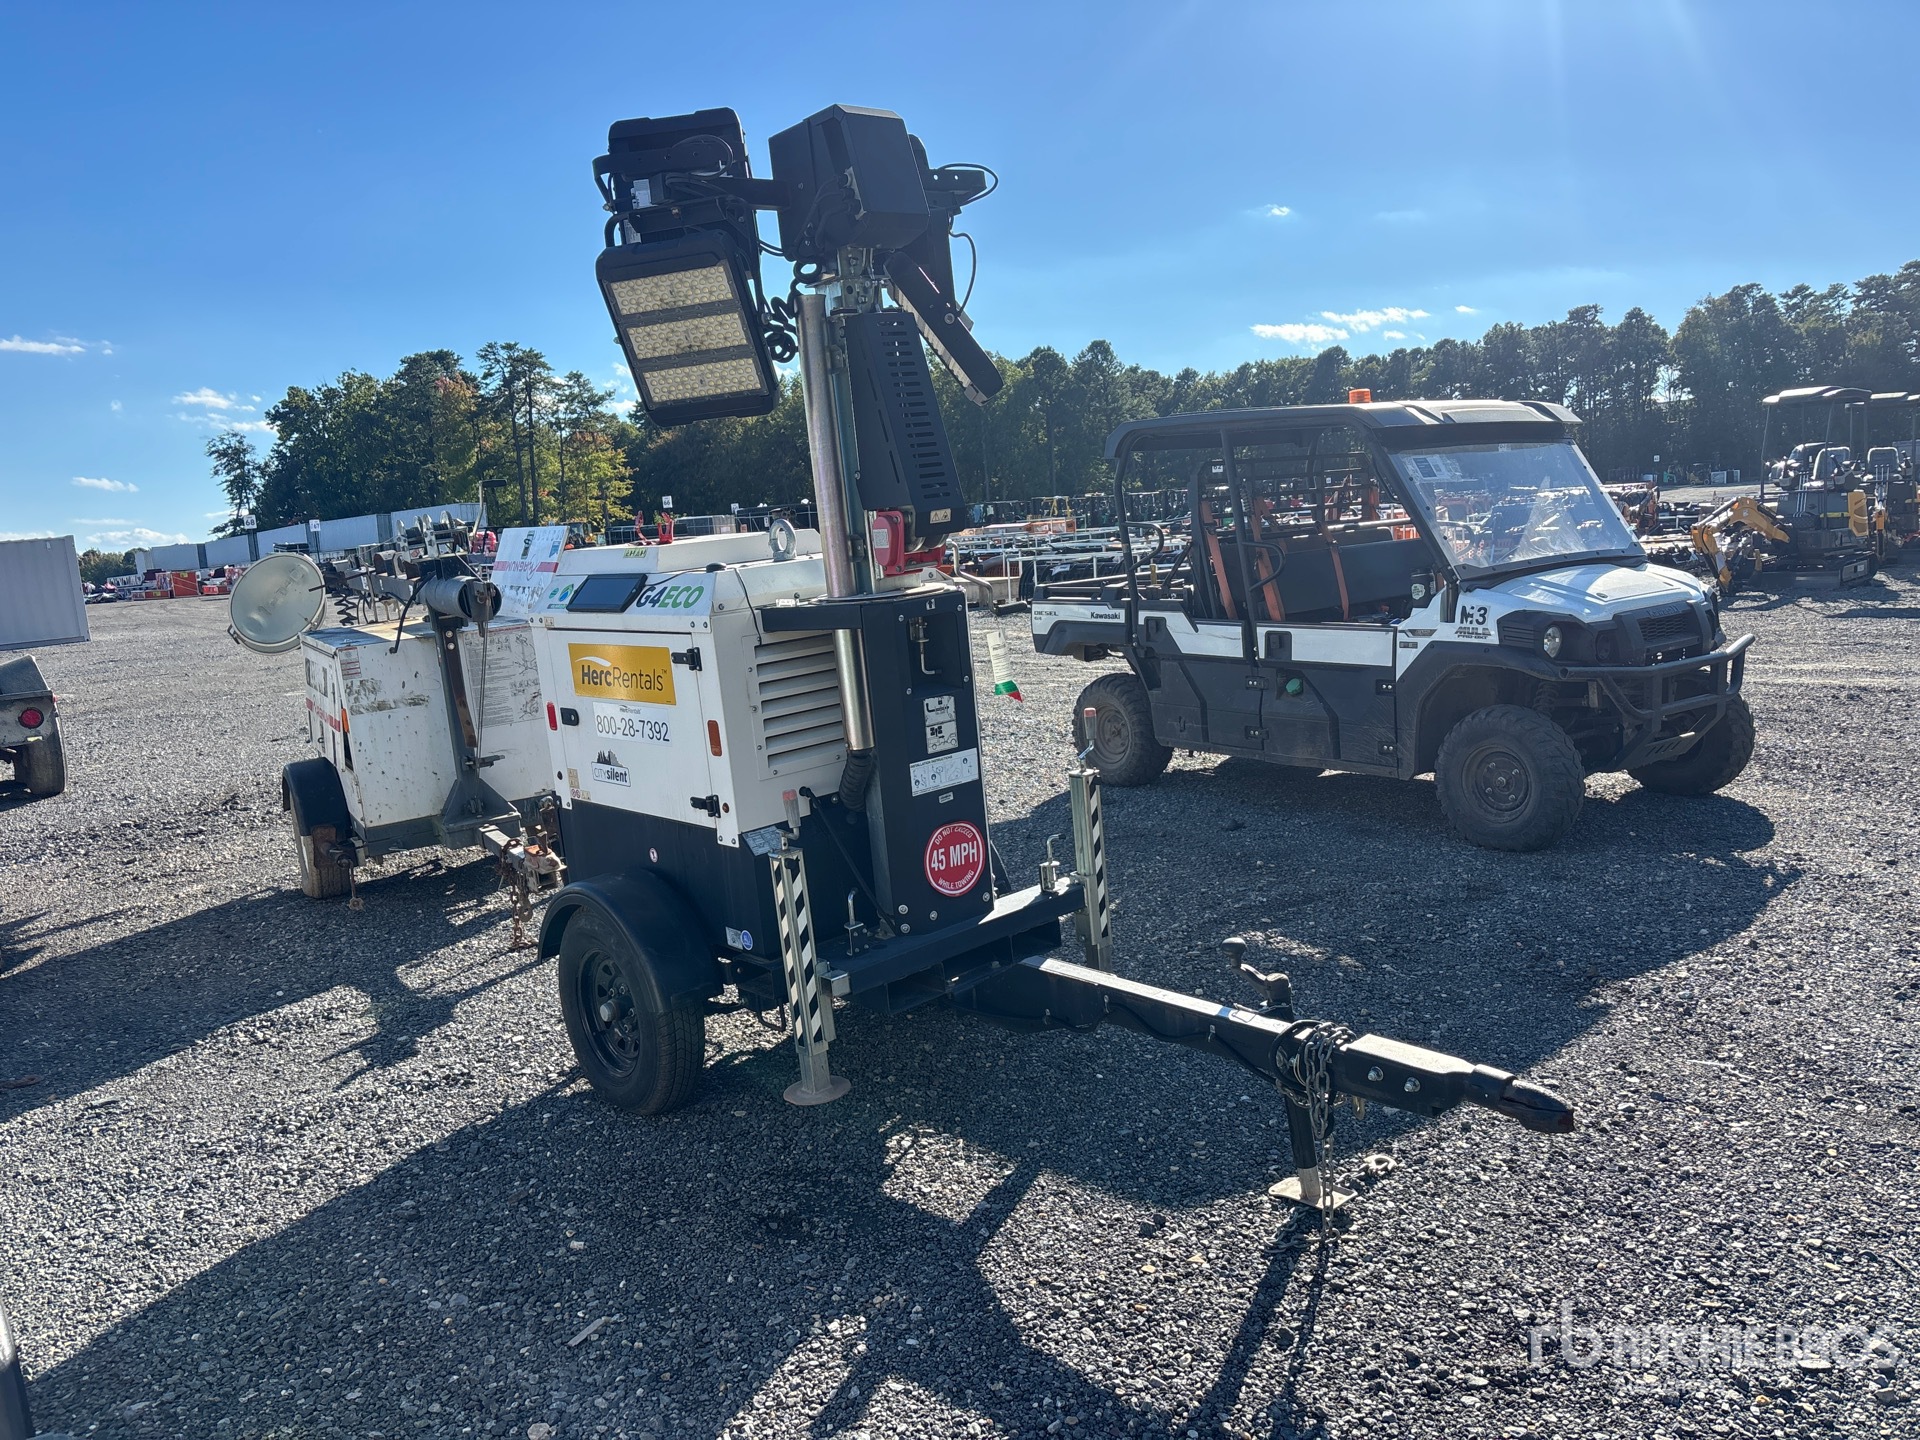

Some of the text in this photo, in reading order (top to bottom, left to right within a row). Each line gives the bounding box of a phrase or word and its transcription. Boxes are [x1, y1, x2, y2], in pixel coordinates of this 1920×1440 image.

[635, 585, 705, 609] G4ECO
[1090, 611, 1121, 620] Kawasaki
[596, 714, 671, 742] 800-28-7392
[934, 826, 974, 845] DO NOT EXCEED
[931, 840, 978, 872] 45 MPH
[938, 869, 975, 890] WHILE TOWING
